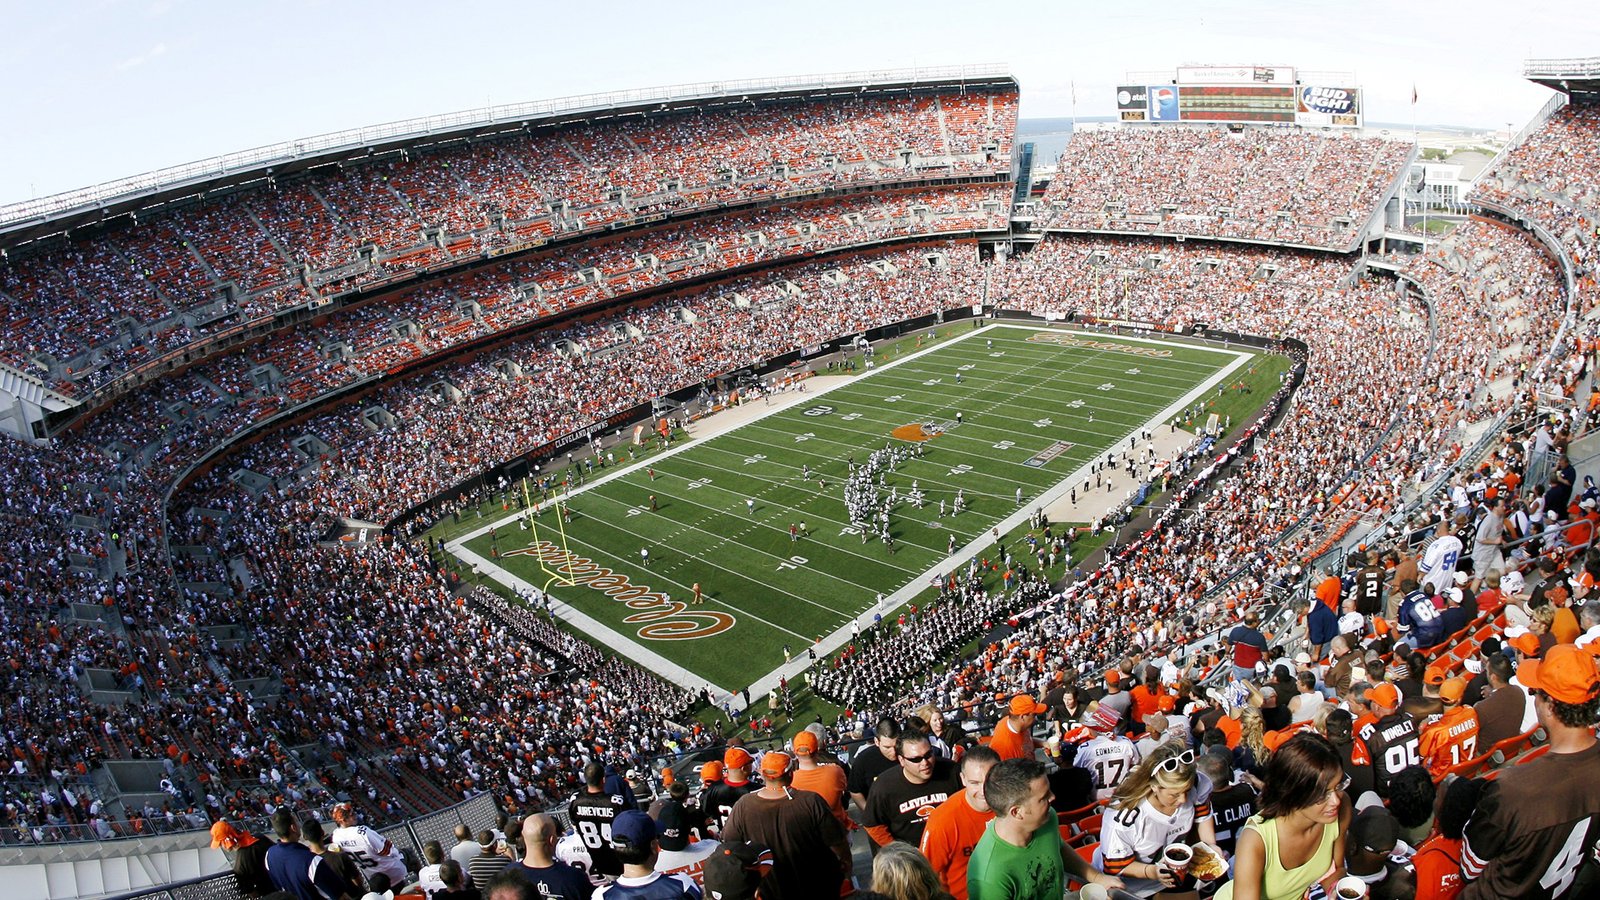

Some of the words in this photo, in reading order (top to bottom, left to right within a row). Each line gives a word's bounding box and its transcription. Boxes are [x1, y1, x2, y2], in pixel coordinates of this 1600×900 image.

[1131, 93, 1147, 101] at&t
[1304, 95, 1350, 110] LIGHT
[1310, 87, 1348, 100] BUD
[554, 429, 588, 449] CLEVELAND
[776, 555, 809, 571] 10
[1441, 550, 1457, 571] 54
[501, 540, 737, 641] Cleveland
[1366, 580, 1378, 598] 2
[1381, 719, 1415, 742] WIMBLEY
[1449, 718, 1476, 737] EDWARDS
[1095, 746, 1121, 757] EDWARDS
[1450, 735, 1477, 766] 17
[1095, 758, 1125, 789] 17
[576, 805, 614, 818] JUREVICIUS
[899, 792, 949, 815] CLEVELAND
[1224, 803, 1252, 823] CLAIR
[1113, 806, 1141, 828] 10
[1538, 815, 1592, 900] 4
